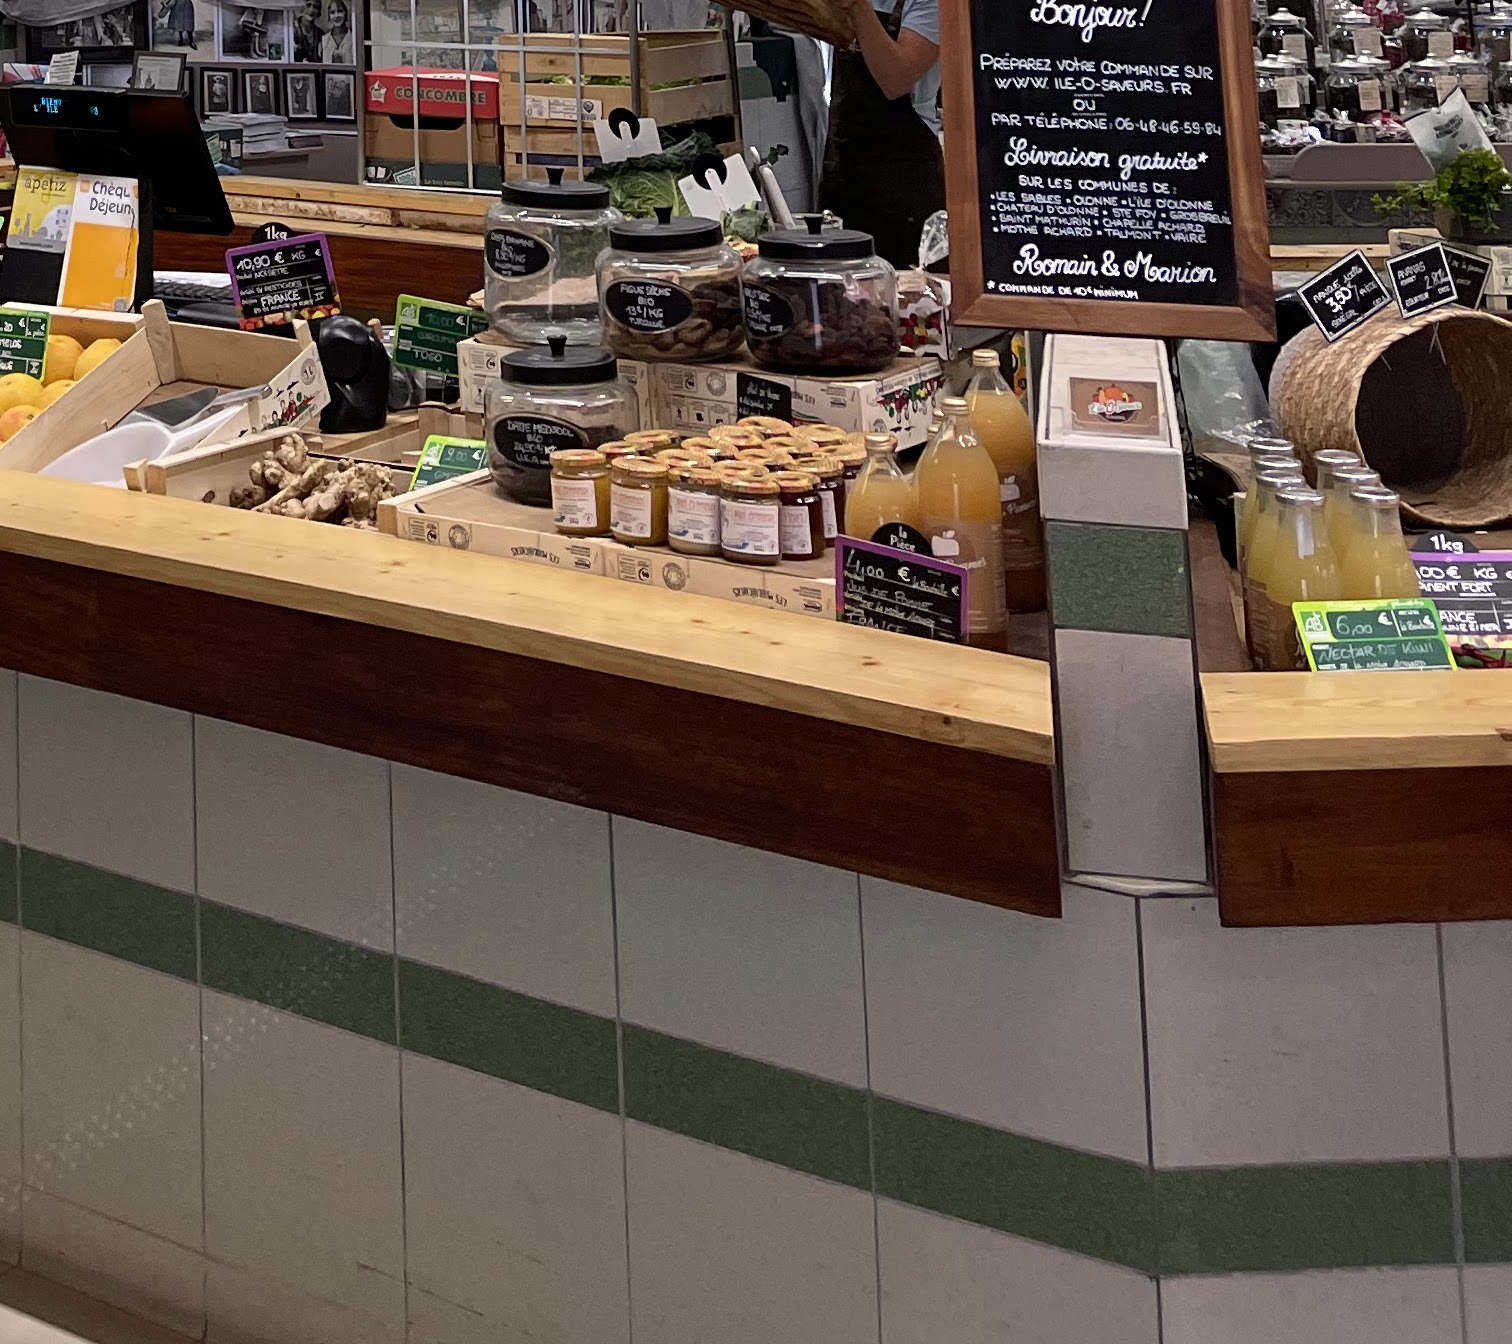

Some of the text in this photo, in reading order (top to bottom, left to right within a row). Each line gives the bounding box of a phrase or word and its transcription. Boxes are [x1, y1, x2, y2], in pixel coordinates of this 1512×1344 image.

[979, 52, 1214, 80] PRÉPAREZ COMMANDE SUR
[395, 86, 487, 105] CONCOMBRE
[1073, 99, 1096, 111] OU
[991, 112, 1022, 128] PAR
[1115, 116, 1222, 137] 06-48-46-59-84
[1004, 135, 1111, 169] Livraison
[24, 176, 67, 194] apetiz
[1019, 175, 1149, 193] SUR LES COMMUNES
[996, 192, 1016, 202] LES
[1020, 193, 1062, 205] SABLES
[1072, 195, 1119, 207] OLONNE
[1044, 226, 1093, 237] ACHARD
[1102, 217, 1155, 230] CHAPELLE
[265, 225, 288, 241] 1kg
[236, 255, 271, 271] 10,90
[274, 251, 285, 264] €
[1013, 243, 1217, 284] Romain & Marion
[260, 289, 301, 307] FRANCE
[1058, 285, 1072, 296] DE
[413, 348, 443, 363] TOGO
[890, 534, 916, 552] Pièce
[1430, 533, 1465, 555] 1kg
[1446, 565, 1499, 580] € KG
[1460, 581, 1494, 595] FORT
[1335, 611, 1393, 637] 6,00 €
[1439, 611, 1476, 624] ANCE
[1319, 643, 1377, 663] NECTAR
